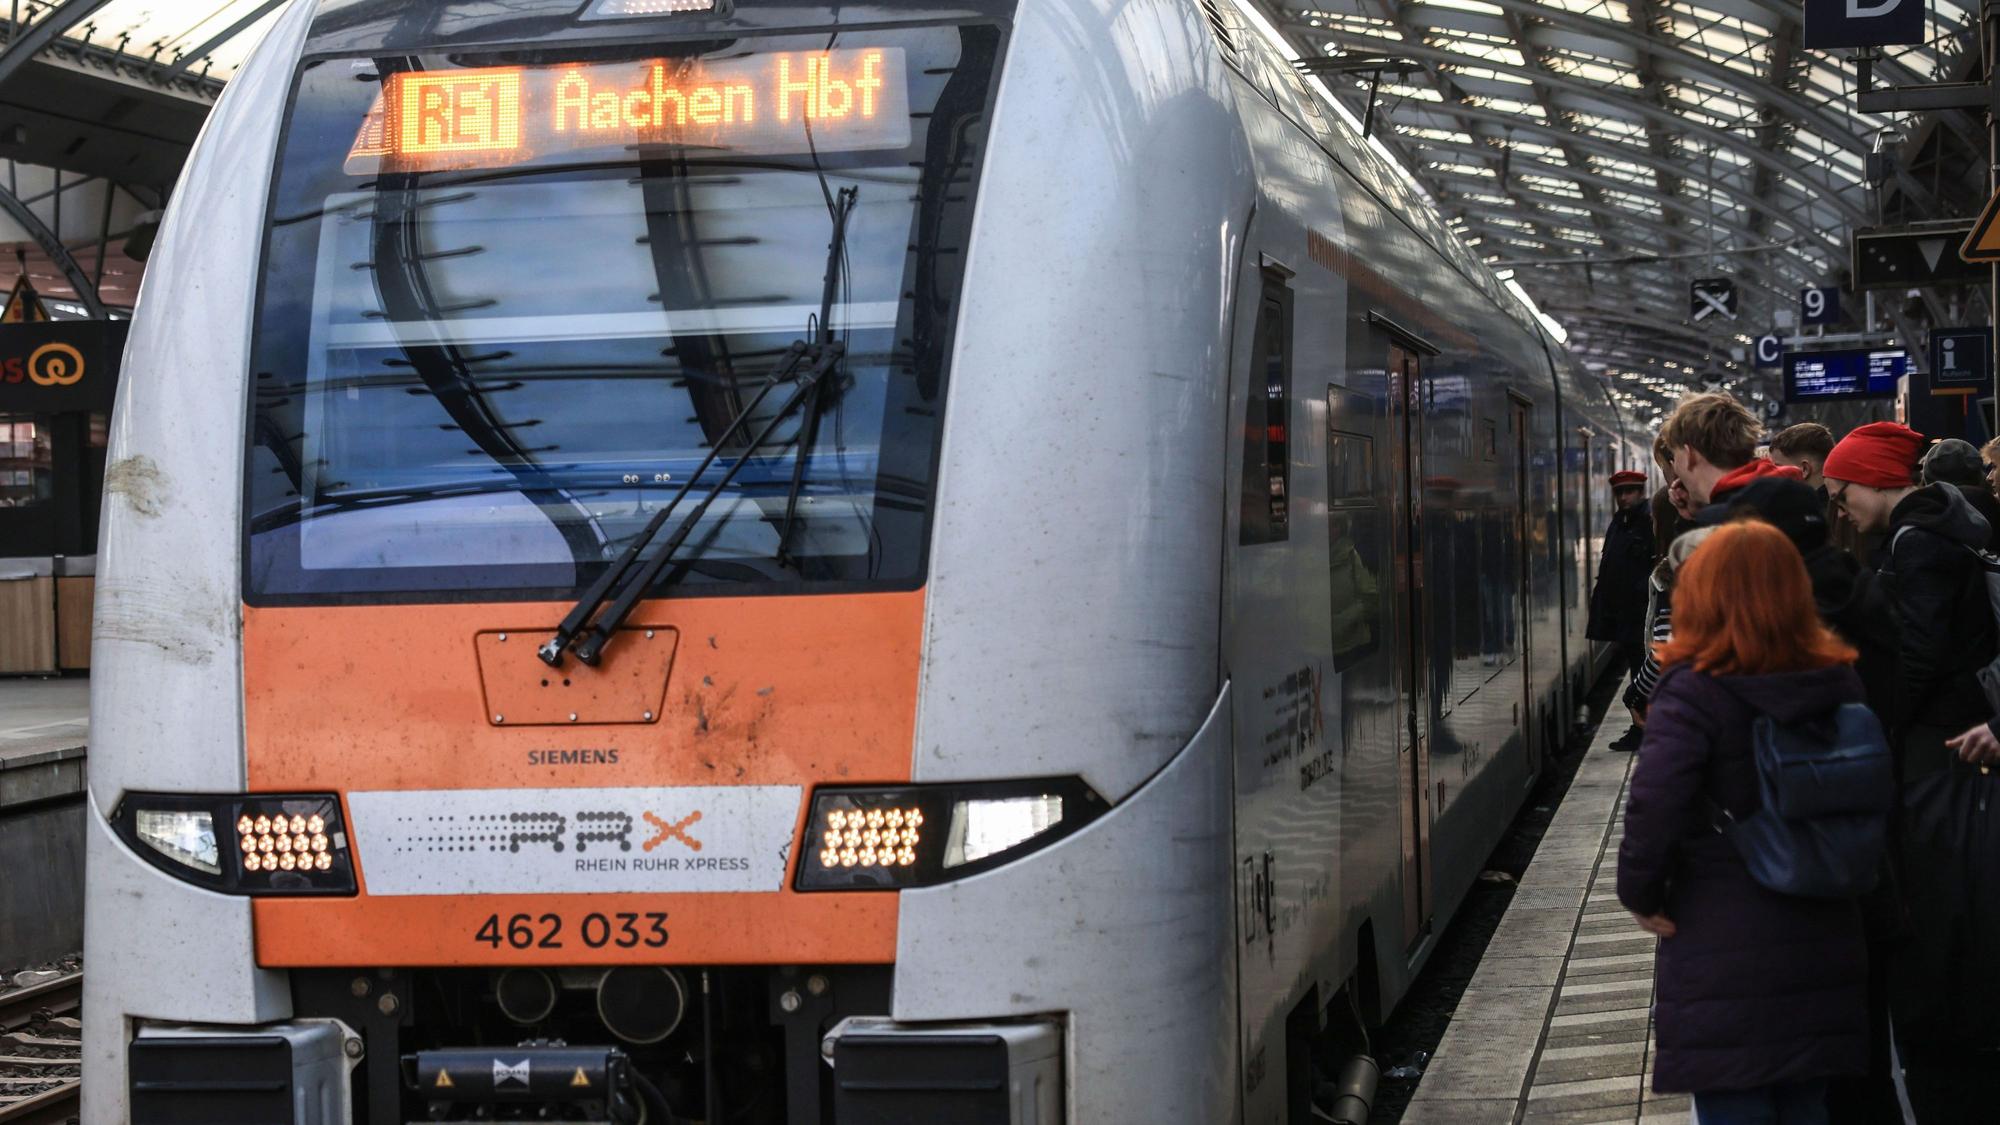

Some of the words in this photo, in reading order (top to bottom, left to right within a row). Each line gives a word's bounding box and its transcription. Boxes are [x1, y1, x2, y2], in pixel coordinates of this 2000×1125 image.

[416, 79, 507, 146] RE1
[554, 65, 754, 131] Aachen
[777, 52, 882, 120] Hbf
[1805, 290, 1825, 316] 9
[1758, 337, 1778, 362] C
[527, 749, 619, 765] SIEMENS
[510, 811, 702, 853] RRX
[575, 858, 626, 872] RHEIN
[632, 857, 680, 871] RUHR
[684, 857, 750, 871] XPRESS
[474, 913, 563, 949] 462
[580, 912, 670, 948] 033
